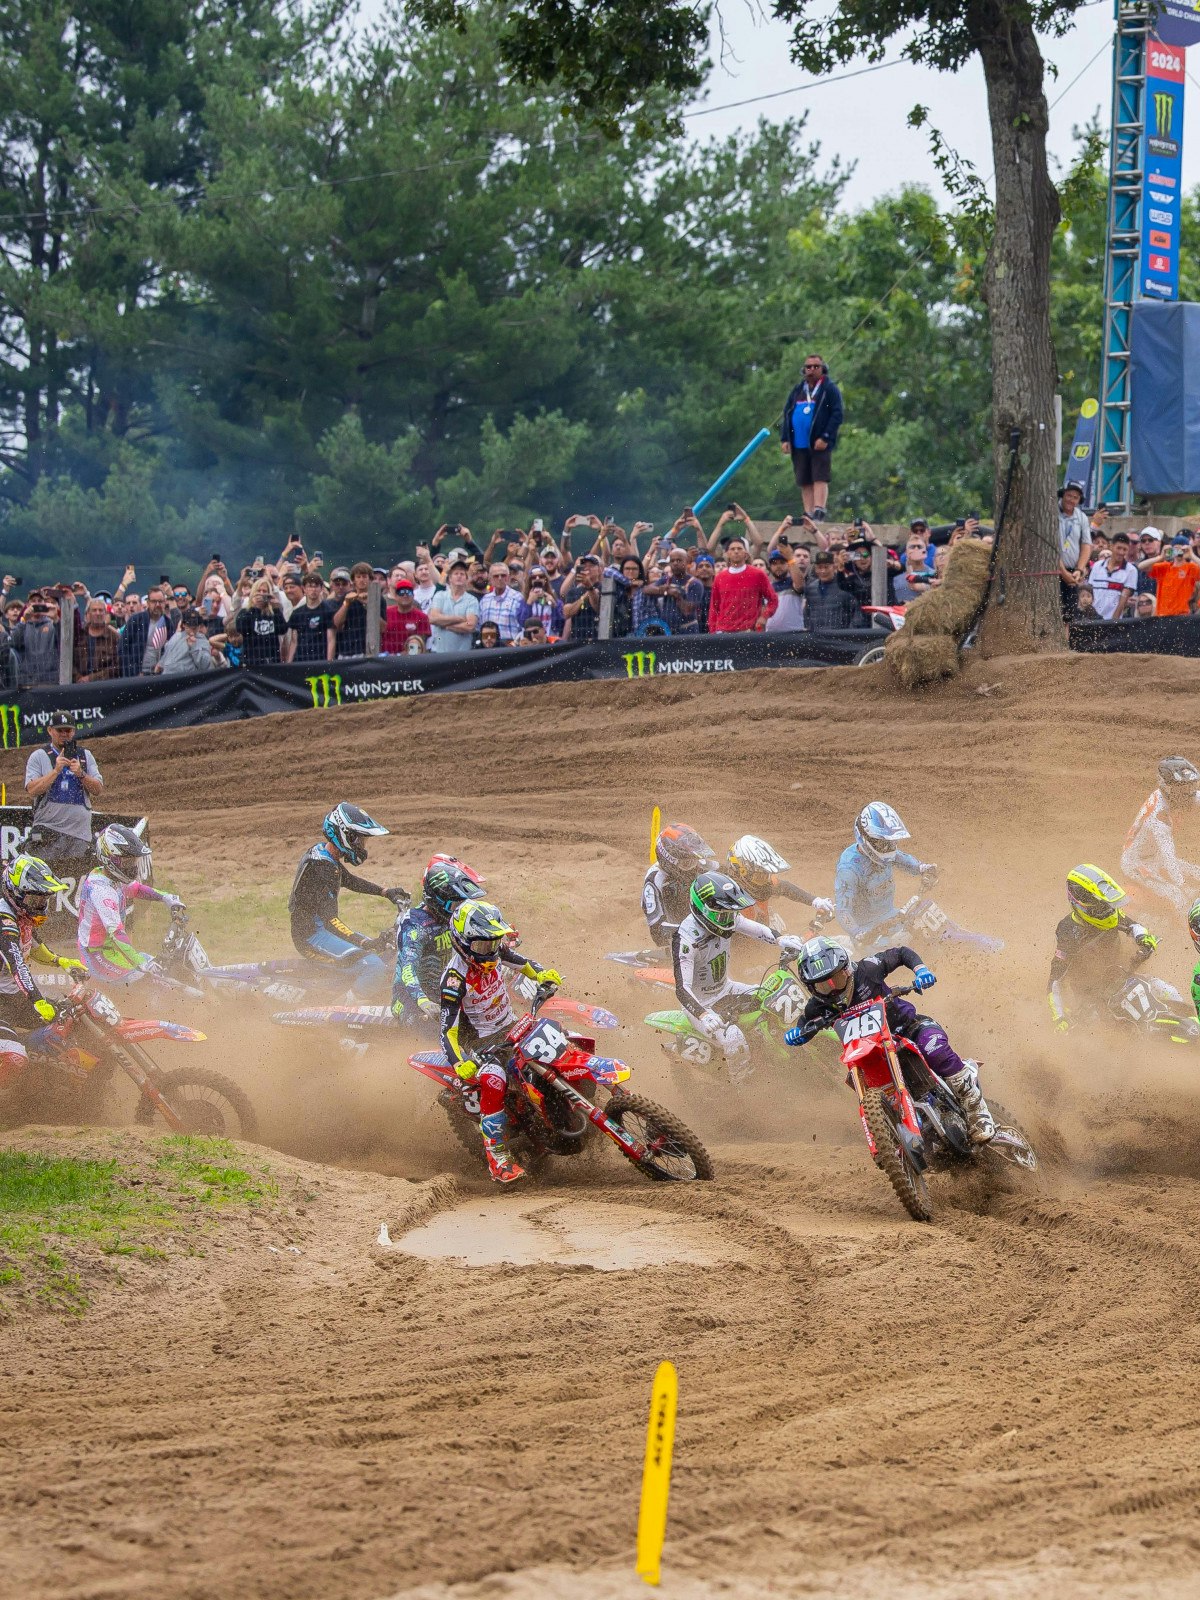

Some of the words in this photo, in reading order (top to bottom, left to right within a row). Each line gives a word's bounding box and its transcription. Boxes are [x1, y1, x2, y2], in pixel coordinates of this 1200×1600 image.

[1151, 51, 1181, 72] 2024
[658, 658, 735, 675] MONSTER
[344, 680, 425, 697] MONSTER
[24, 706, 104, 727] MOTER
[776, 984, 808, 1024] 29
[1121, 984, 1150, 1020] 17
[843, 1009, 882, 1045] 48
[527, 1023, 570, 1064] 34
[681, 1037, 711, 1064] 29
